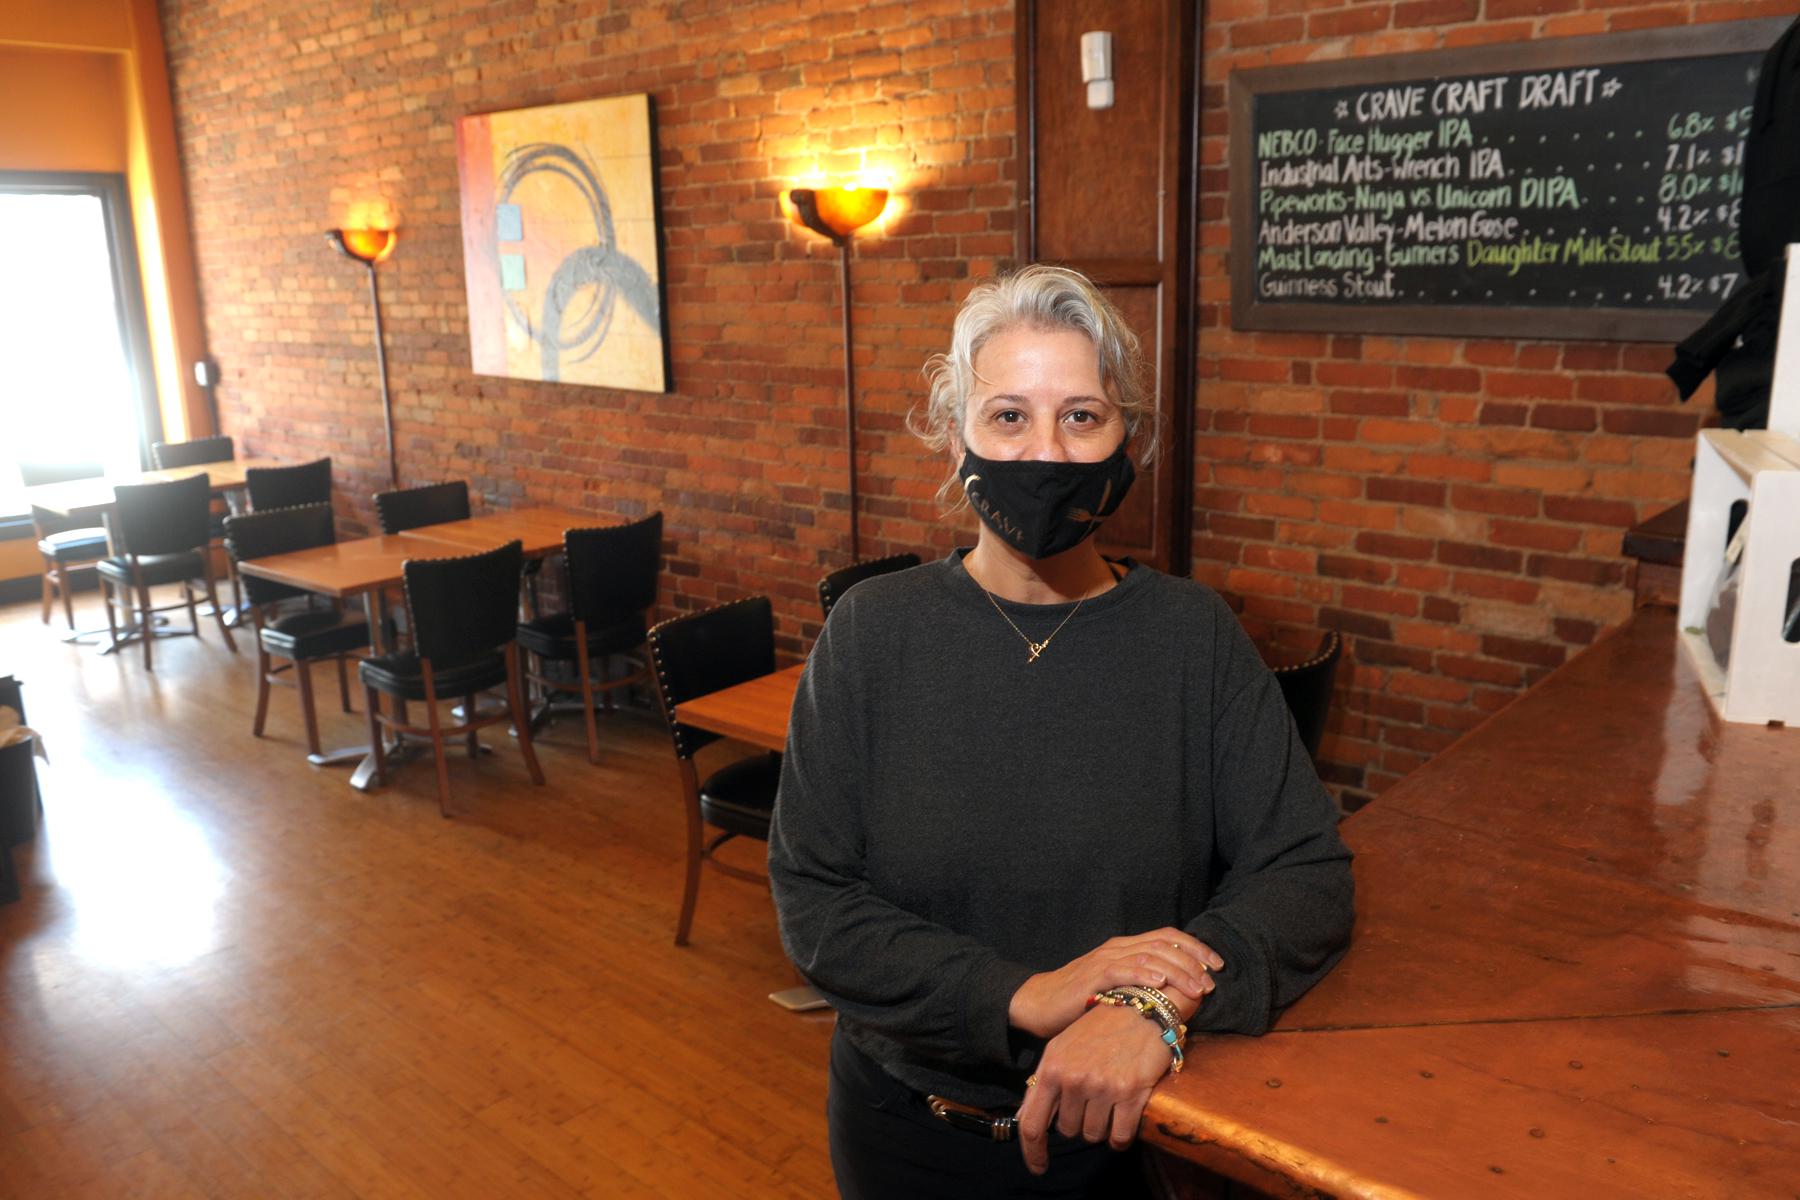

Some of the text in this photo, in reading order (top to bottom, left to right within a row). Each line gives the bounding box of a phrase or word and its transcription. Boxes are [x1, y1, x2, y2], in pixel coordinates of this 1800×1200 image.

[1356, 69, 1600, 122] CRAVE CRAFT DRAFT
[1328, 128, 1365, 155] Face
[1367, 127, 1434, 160] Hugger
[1438, 118, 1473, 148] IPA
[1260, 158, 1339, 188] Industrial
[1469, 148, 1505, 178] IPA
[1410, 187, 1431, 207] vs
[1436, 182, 1512, 210] Unicorn
[1519, 177, 1580, 210] DIPA
[1259, 218, 1342, 245] Anderson
[1469, 209, 1519, 240] Gose
[1259, 246, 1302, 272] Mast
[1467, 236, 1560, 277] Daughter
[1260, 271, 1339, 298] Guinness
[1343, 268, 1395, 298] Stout
[1708, 273, 1739, 300] $7
